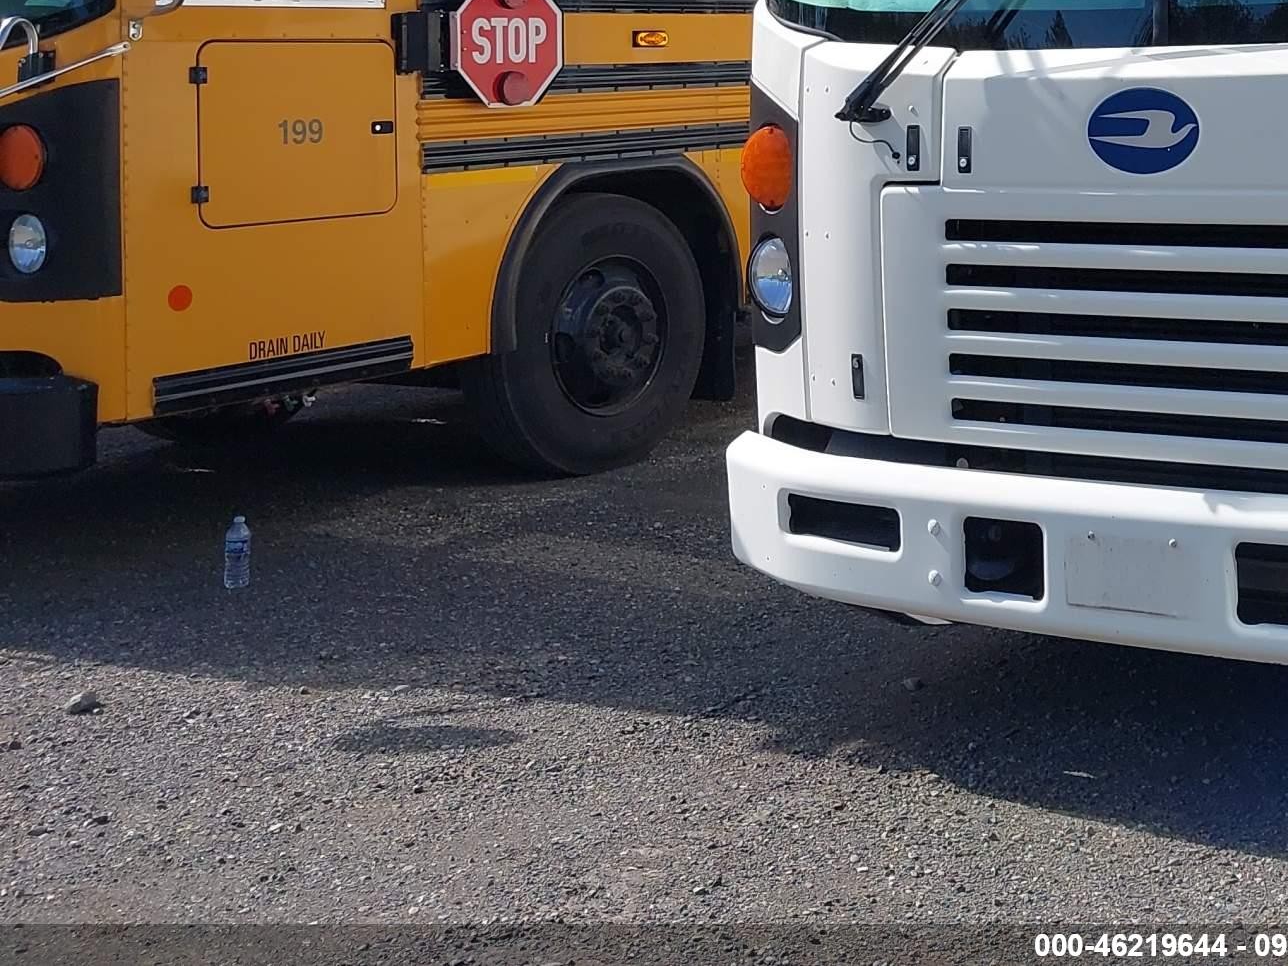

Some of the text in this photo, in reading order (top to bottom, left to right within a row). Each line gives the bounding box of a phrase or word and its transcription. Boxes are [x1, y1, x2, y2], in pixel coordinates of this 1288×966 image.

[471, 17, 547, 65] STOP
[277, 118, 324, 145] 199
[249, 329, 326, 360] DRAIN DAILY
